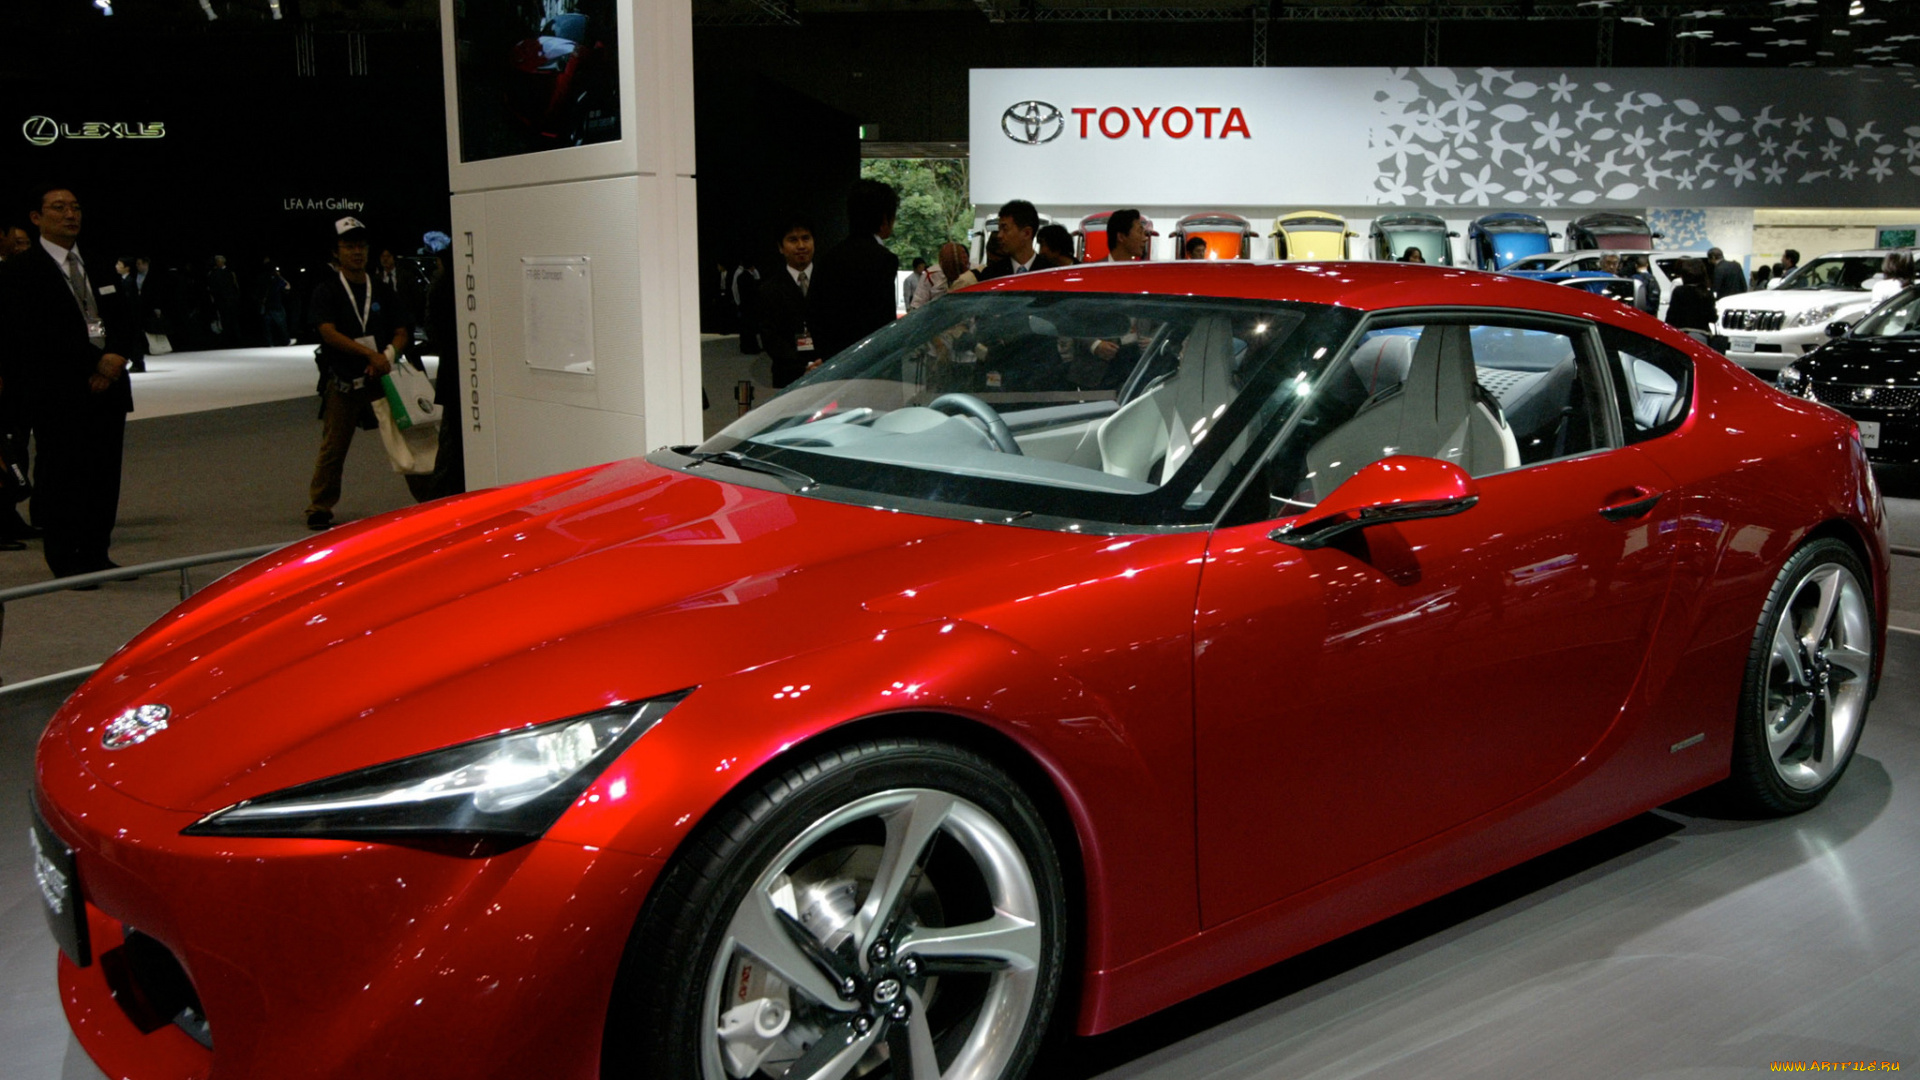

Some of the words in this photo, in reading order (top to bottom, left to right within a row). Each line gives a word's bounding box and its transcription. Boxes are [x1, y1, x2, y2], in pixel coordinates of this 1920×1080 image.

[60, 122, 166, 139] LEXUS
[1071, 105, 1251, 139] TOYOTA
[283, 198, 304, 210] LFA
[306, 198, 324, 210] Art
[325, 197, 364, 212] Gallery
[464, 231, 477, 312] FT-86
[468, 322, 481, 432] Concept
